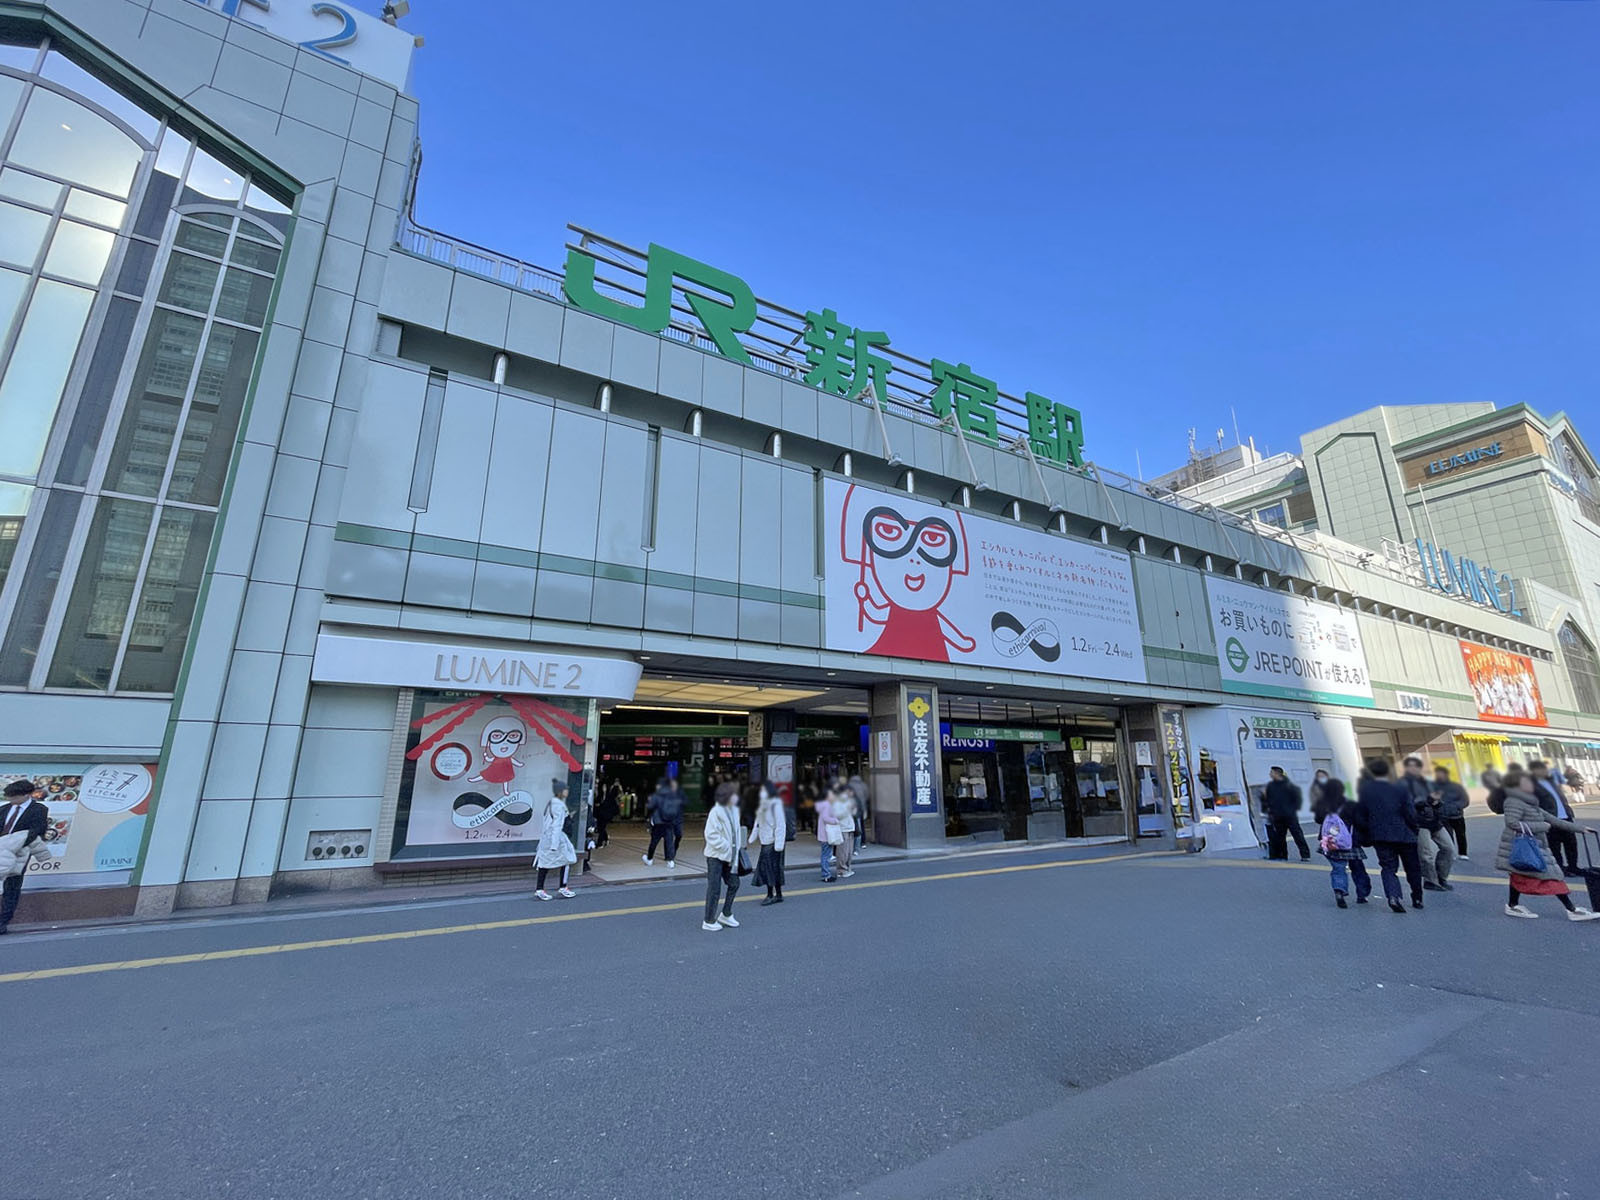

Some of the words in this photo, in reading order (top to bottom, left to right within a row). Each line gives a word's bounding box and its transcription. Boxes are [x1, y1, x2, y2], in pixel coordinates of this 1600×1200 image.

[564, 242, 758, 364] JR
[803, 308, 1088, 477] 新宿駅
[1428, 441, 1504, 475] LUMINE
[1416, 537, 1503, 612] LUMINE
[1501, 573, 1522, 617] 2
[1008, 622, 1047, 656] ethicarnival
[1220, 608, 1295, 640] お買いものに
[434, 653, 559, 688] LUMINE
[564, 664, 583, 690] 2
[1254, 651, 1283, 675] JRE
[1282, 654, 1323, 681] POINT
[1467, 651, 1493, 673] HAPPY
[1492, 651, 1512, 669] NEW
[683, 754, 705, 768] JR
[912, 719, 932, 806] 住友不動産
[88, 788, 127, 799] KITCHEN
[469, 793, 520, 827] ethicarnival
[29, 861, 62, 872] OOR
[101, 857, 133, 866] LUMINE
